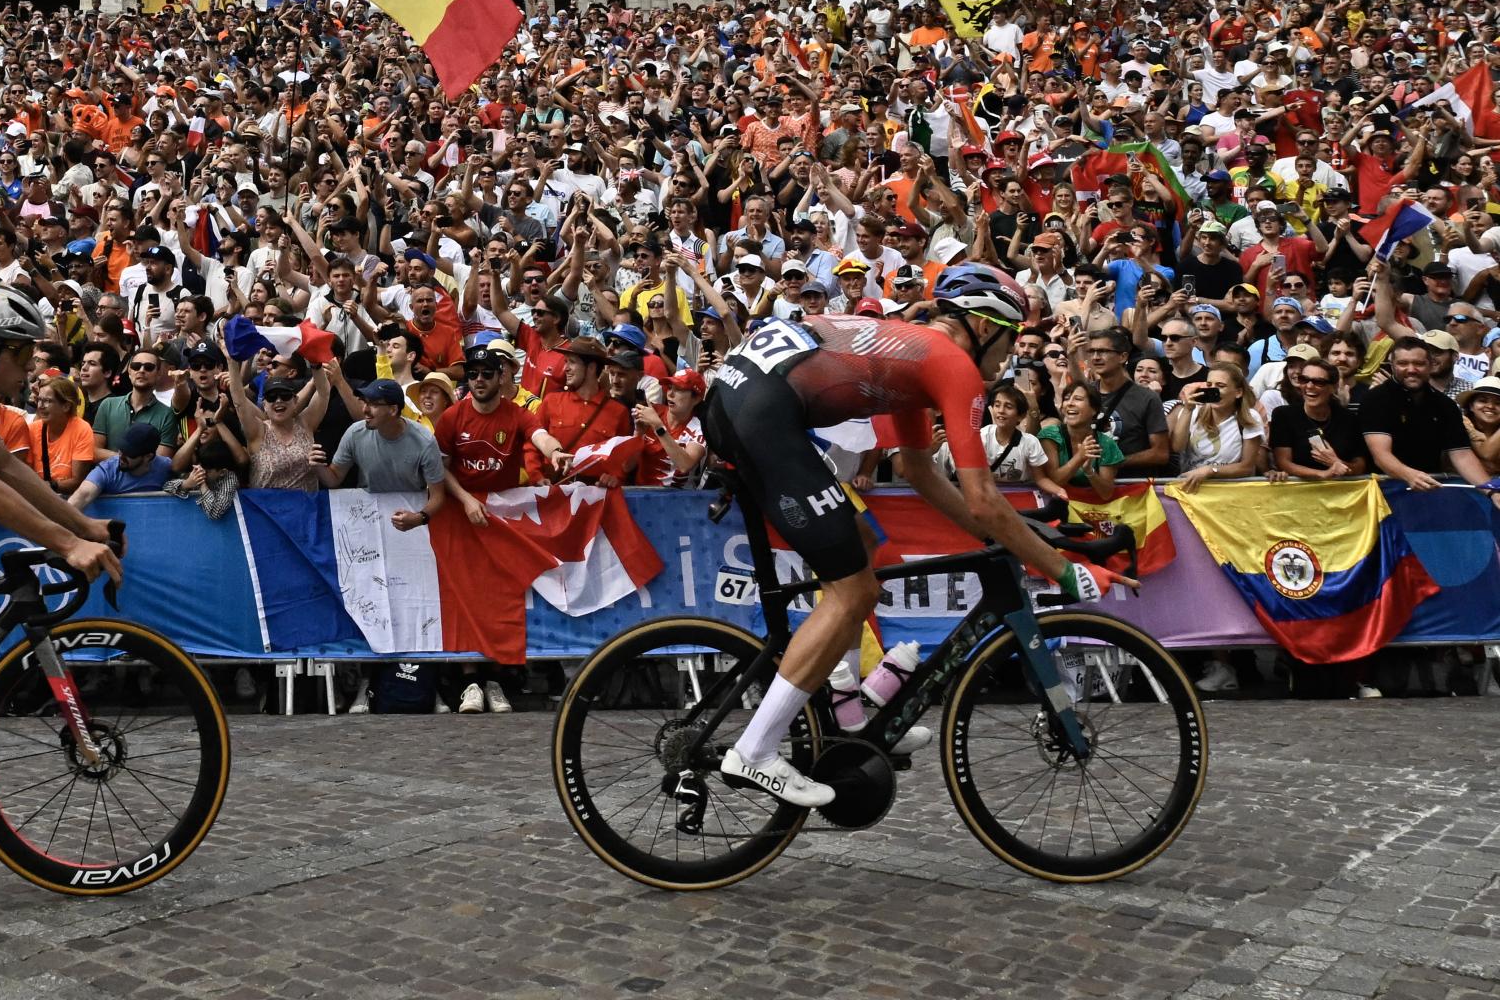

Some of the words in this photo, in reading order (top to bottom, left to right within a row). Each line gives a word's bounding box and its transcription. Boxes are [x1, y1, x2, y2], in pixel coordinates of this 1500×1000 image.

[750, 328, 801, 360] 67
[462, 458, 485, 471] ING
[719, 577, 747, 600] 67
[954, 720, 968, 784] RESERVE
[1186, 711, 1200, 775] RESERVE
[564, 758, 590, 821] RESERVE
[741, 764, 787, 795] nimbl
